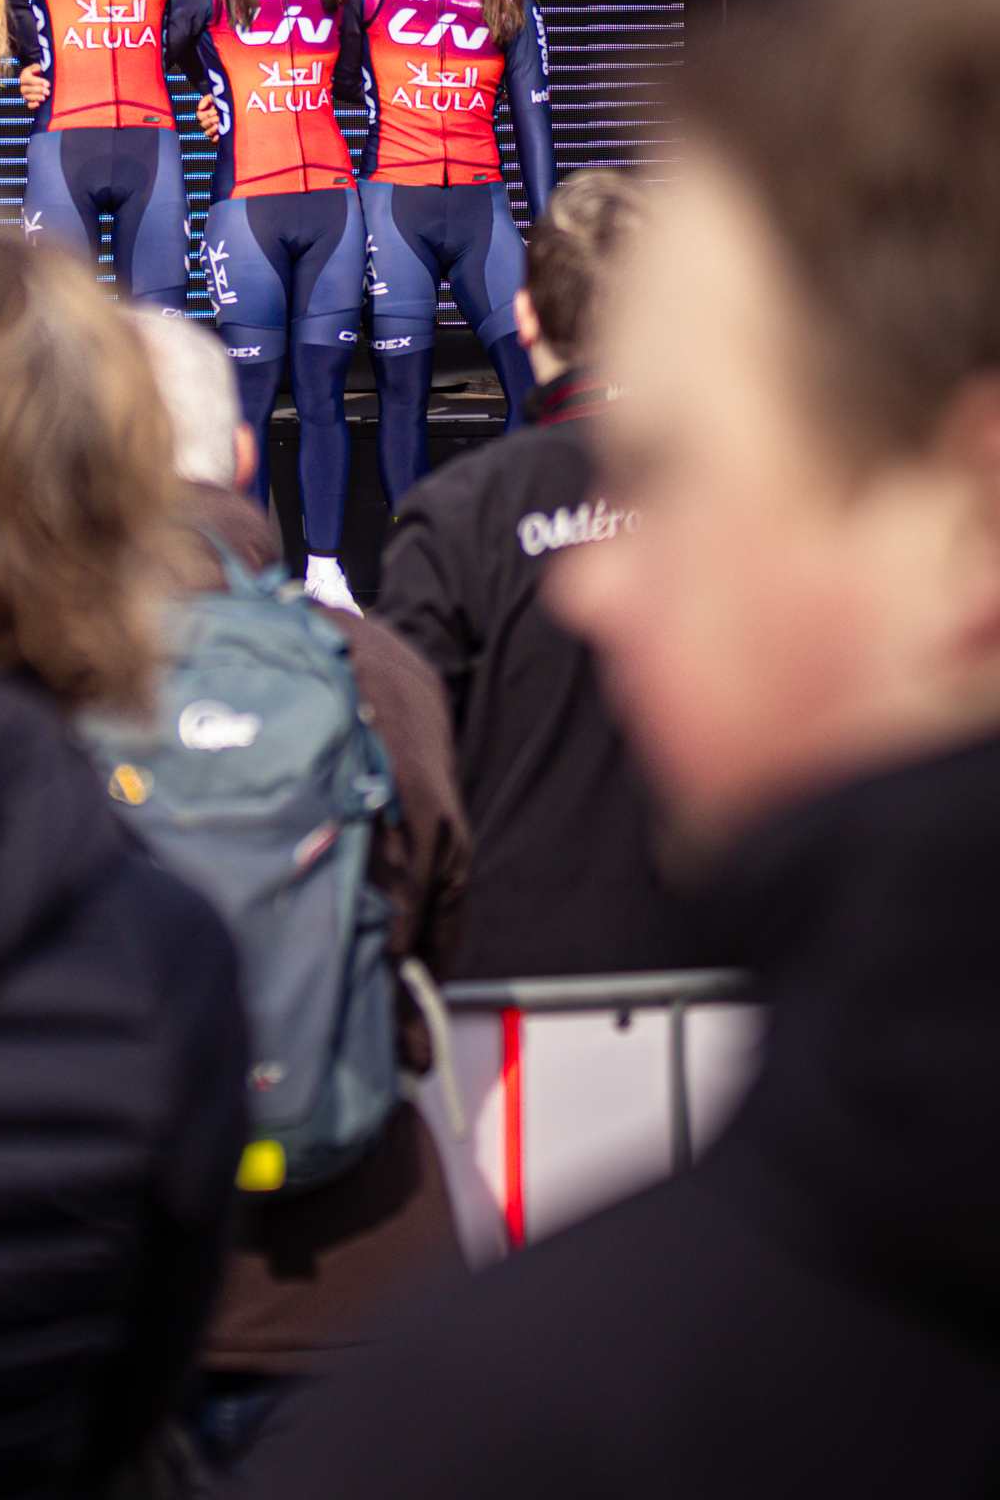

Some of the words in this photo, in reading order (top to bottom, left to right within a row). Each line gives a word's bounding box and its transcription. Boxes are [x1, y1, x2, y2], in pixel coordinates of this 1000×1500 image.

[62, 26, 158, 51] ALULA
[387, 7, 490, 50] Liv
[245, 88, 330, 114] ALULA
[391, 86, 487, 112] ALULA
